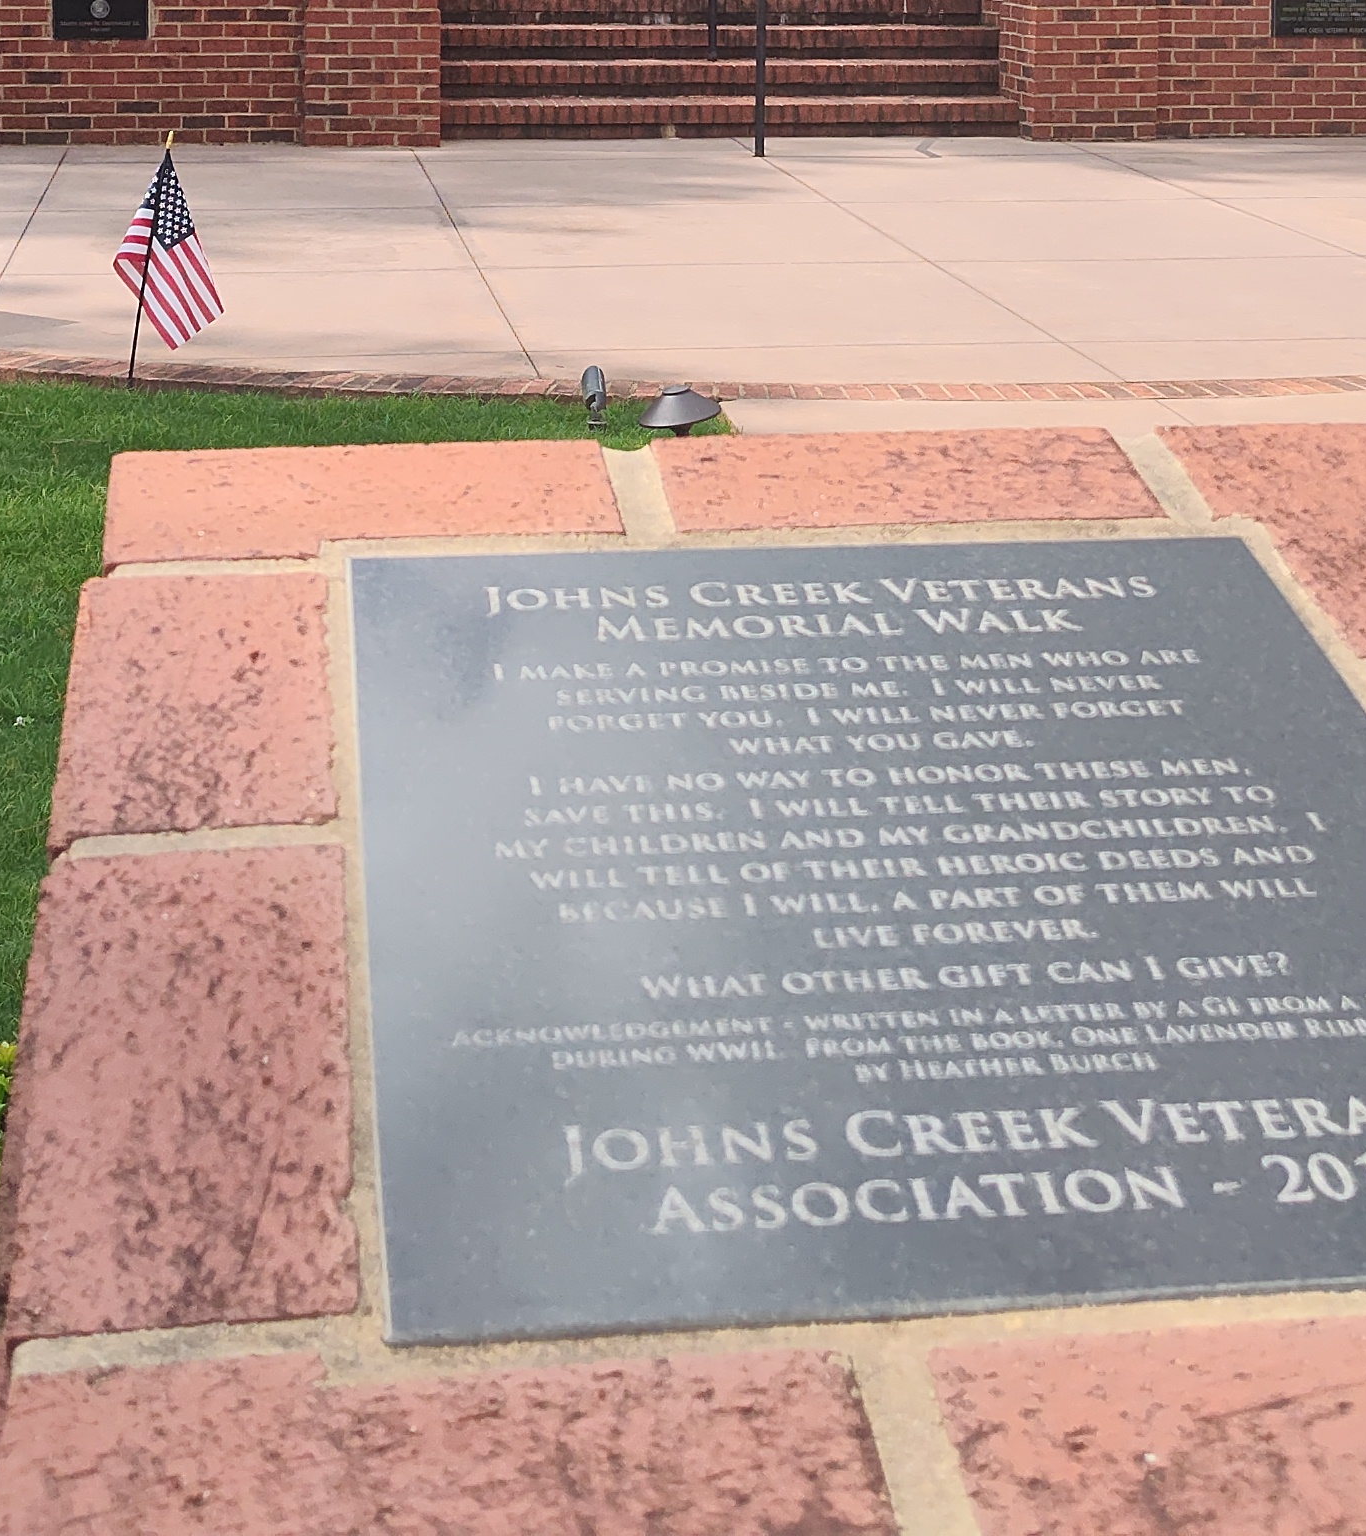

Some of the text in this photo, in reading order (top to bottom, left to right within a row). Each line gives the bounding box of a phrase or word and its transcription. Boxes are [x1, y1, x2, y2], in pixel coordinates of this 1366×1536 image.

[483, 576, 1156, 617] JOHNS CREEK VETERANS
[597, 608, 1083, 642] MEMORIAL WALK
[493, 649, 1201, 681] I MAKE A PROMISE TO THE MEN WHO ARE
[556, 674, 1164, 706] SERVING BESIDE ME. I WILL NEVER
[546, 712, 686, 733] FORGET
[807, 706, 821, 726] I
[829, 705, 921, 726] WILL
[929, 703, 1046, 723] NEVER
[1049, 699, 1184, 720] FORGET
[728, 729, 1035, 756] WHAT YOU GAVE.
[529, 775, 543, 796] I
[558, 775, 651, 795] HAVE
[667, 772, 726, 792] NO
[736, 769, 811, 790] WAY
[821, 767, 877, 787] TO
[888, 763, 1034, 785] HONOR
[1035, 758, 1153, 781] THESE
[524, 805, 611, 827] SAVE
[749, 798, 763, 819] I
[775, 797, 869, 818] WILL
[877, 794, 967, 816] TELL
[971, 789, 1092, 813] THEIR
[1098, 787, 1212, 808] STORY
[1220, 785, 1277, 805] TO
[494, 812, 1327, 859] MY CHILDREN AND MY GRANDCHILDREN. I
[530, 845, 1316, 890] WILL TELL OF THEIR HEROIC DEEDS AND
[558, 897, 729, 924] BECAUSE
[744, 893, 758, 917] I
[893, 890, 922, 911] A
[928, 886, 1022, 911] PART
[1034, 884, 1087, 906] OF
[1095, 880, 1214, 906] THEM
[1218, 876, 1318, 899] WILL
[813, 918, 1100, 948] LIVE FOREVER.
[639, 951, 1290, 999] WHAT OTHER GIFT CAN I GIVE?
[452, 1016, 773, 1048] ACKNOWLEDGEMENT
[803, 1010, 937, 1034] WRITTEN
[949, 1007, 983, 1027] IN
[993, 1006, 1015, 1024] A
[1021, 1001, 1129, 1023] LETTER
[1133, 1001, 1167, 1019] BY
[1177, 1000, 1199, 1018] A
[1247, 995, 1332, 1015] FROM
[1340, 995, 1361, 1011] A
[552, 1045, 676, 1070] DURING
[804, 1037, 891, 1058] FROM
[903, 1035, 962, 1054] THE
[1071, 1025, 1138, 1047] ONE
[1144, 1019, 1298, 1044] LAVENDER
[855, 1052, 1158, 1083] BY HEATHER BURCH
[562, 1119, 819, 1186] JOHNS
[846, 1107, 1098, 1158] CREEK
[647, 1166, 1187, 1234] ASSOCIATION
[1213, 1180, 1242, 1195] -
